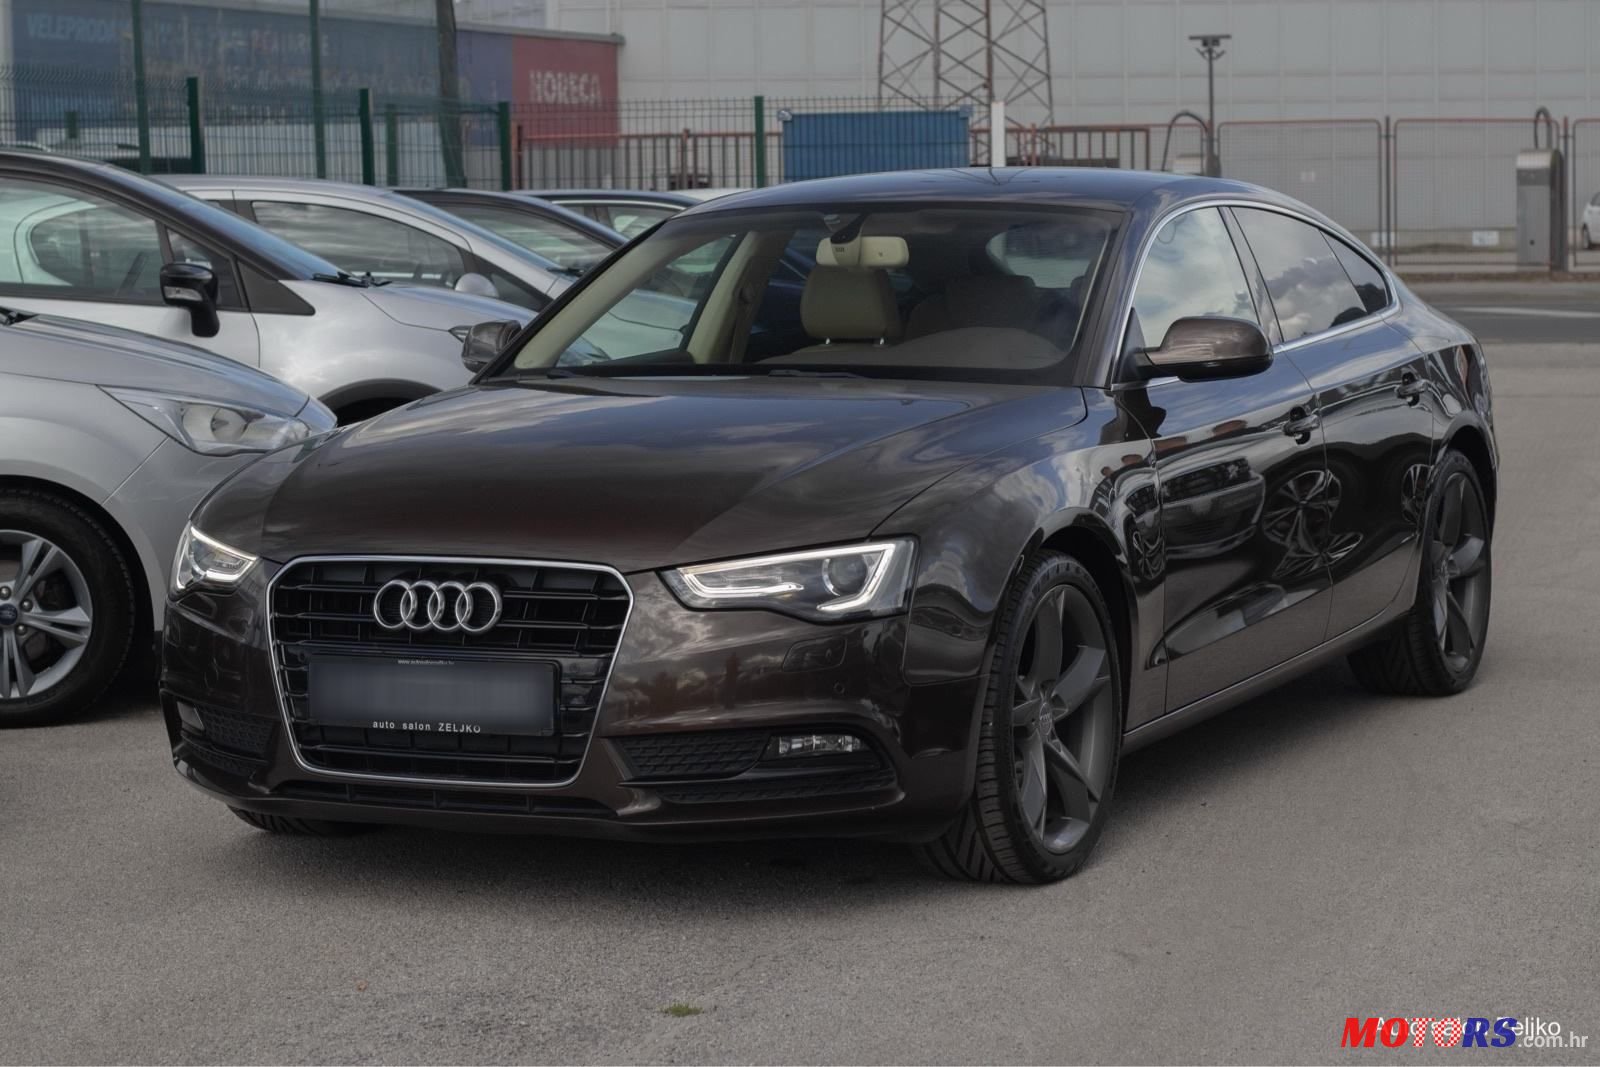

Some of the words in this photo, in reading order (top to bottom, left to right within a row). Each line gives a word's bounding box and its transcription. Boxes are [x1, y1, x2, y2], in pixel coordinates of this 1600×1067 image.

[529, 69, 601, 105] HORECA
[372, 720, 395, 729] auto
[402, 721, 431, 731] salon
[438, 722, 481, 733] ZELJKO
